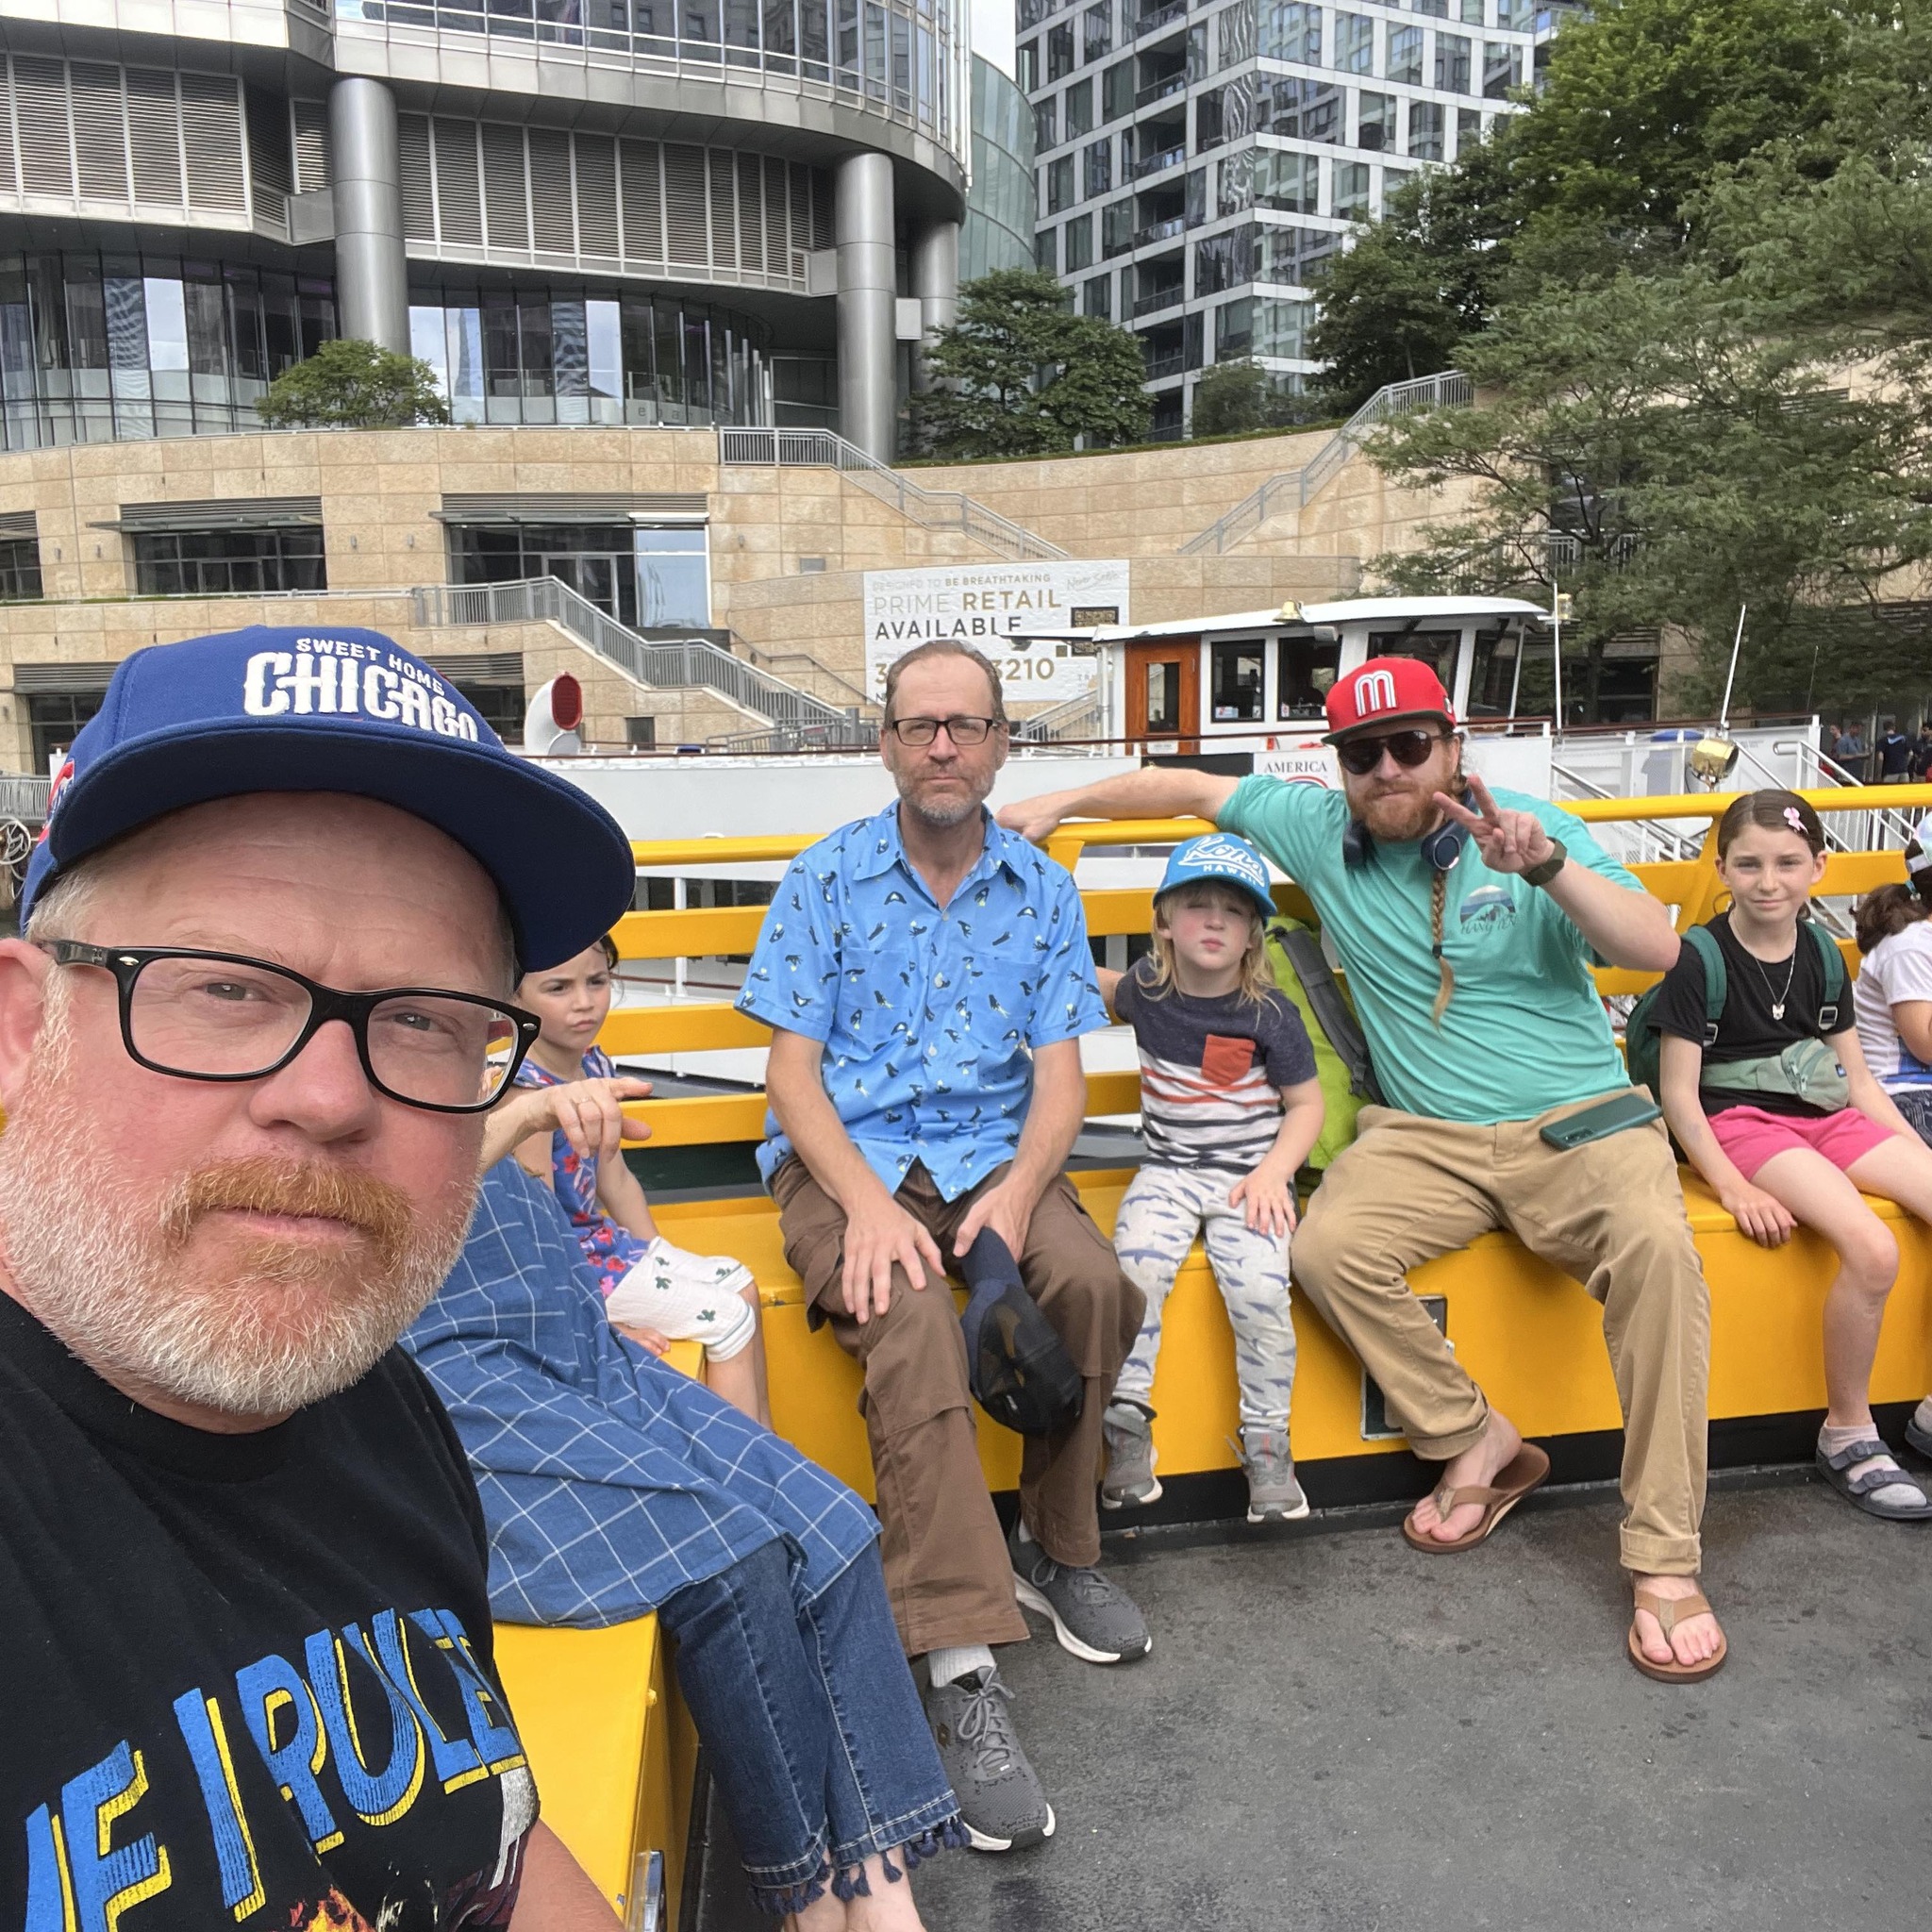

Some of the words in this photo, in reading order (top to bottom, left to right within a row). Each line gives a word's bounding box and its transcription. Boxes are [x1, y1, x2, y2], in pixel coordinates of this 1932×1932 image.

[927, 578, 941, 589] TO
[945, 577, 959, 586] BE
[962, 574, 1051, 586] BREATHTAKING
[874, 593, 951, 616] PRIME
[962, 589, 1061, 611] RETAIL
[874, 616, 1022, 641] AVAILABLE
[296, 638, 380, 661] SWEET
[389, 654, 444, 696] HOME
[243, 652, 478, 743] CHICAGO
[1265, 759, 1327, 774] AMERICA
[1179, 836, 1264, 883] Kona
[1203, 864, 1256, 885] HAWAII
[26, 1740, 173, 1932] IF
[173, 1688, 266, 1923] I
